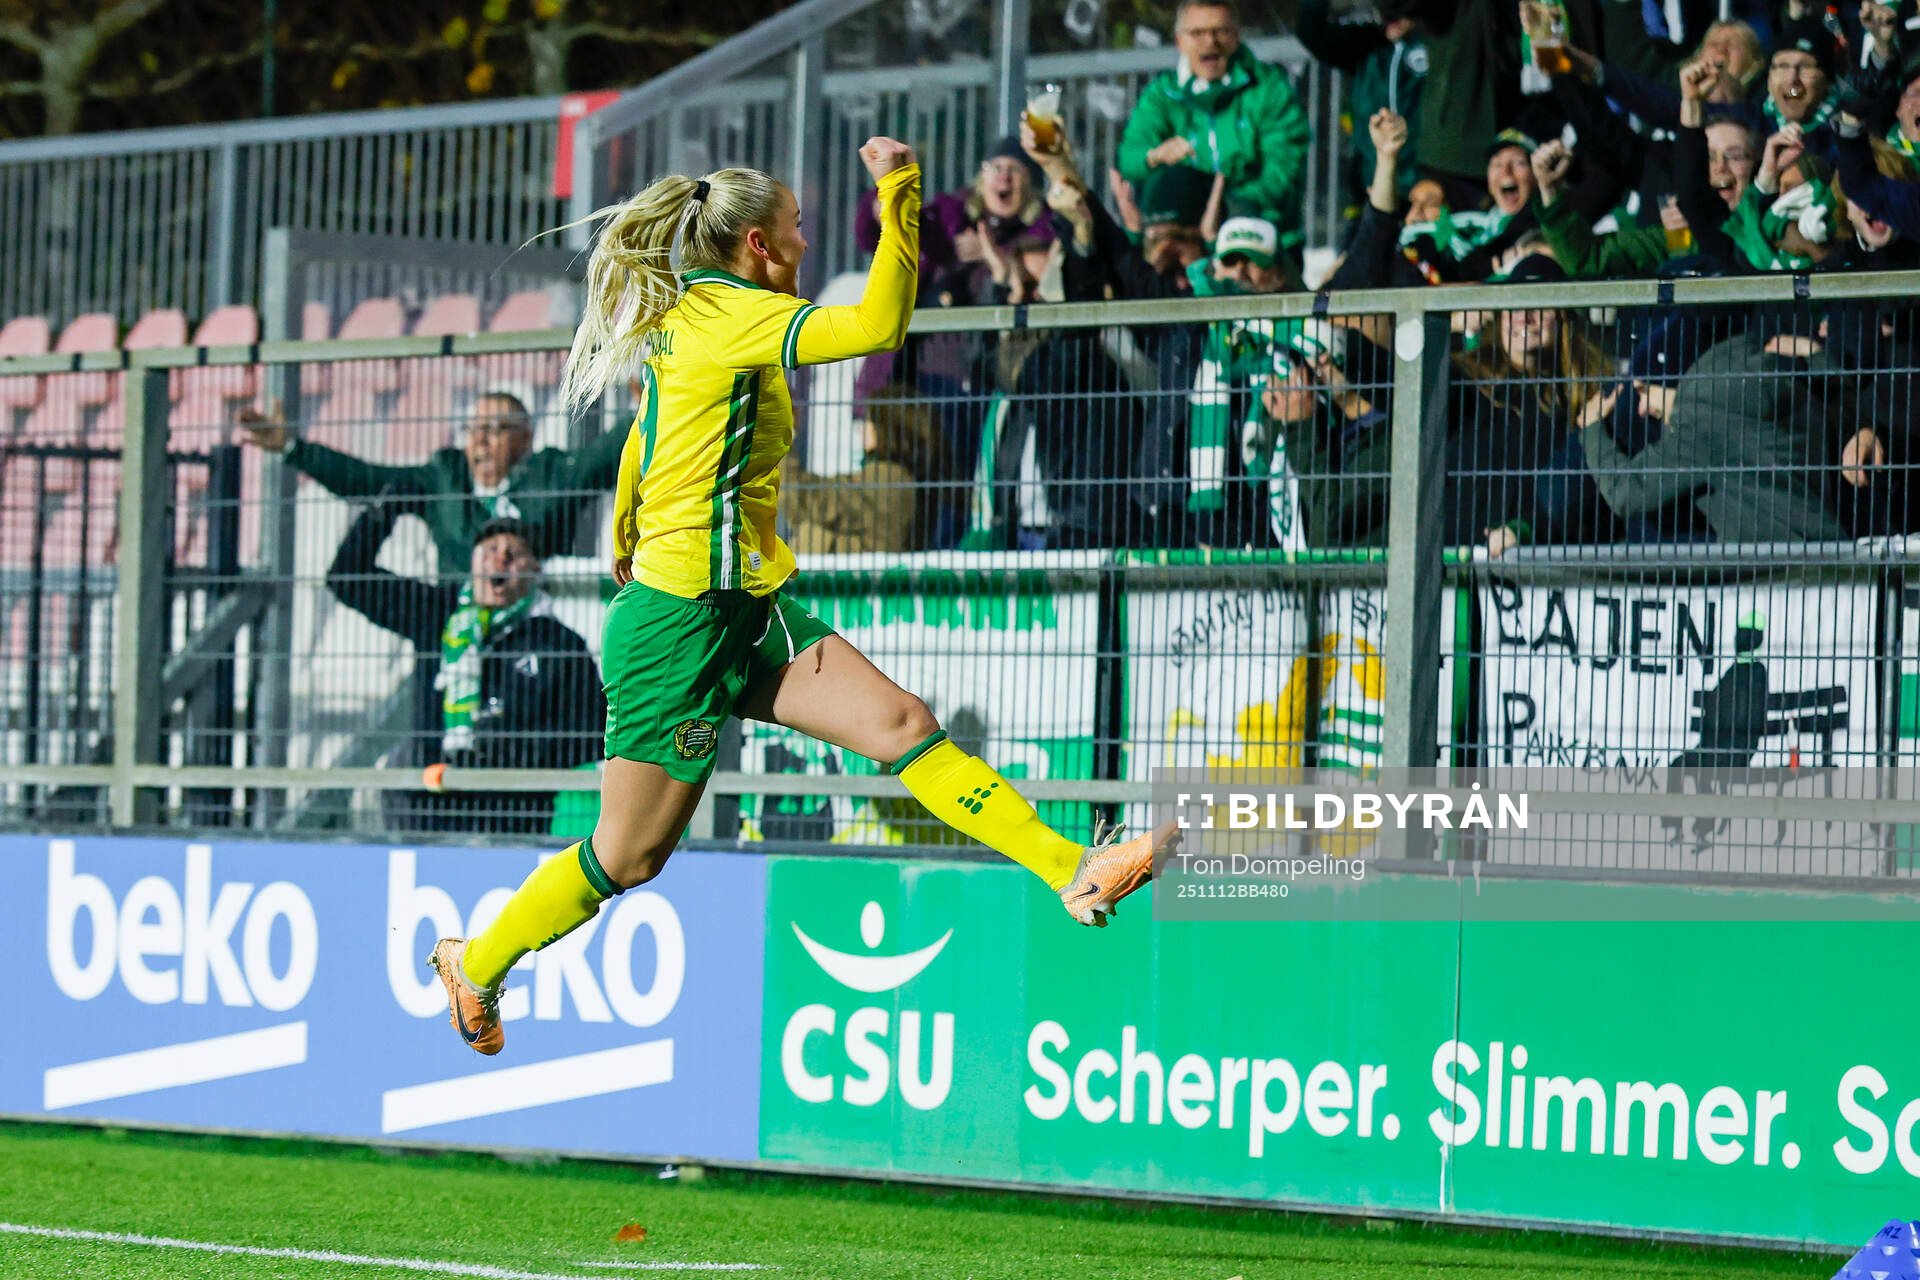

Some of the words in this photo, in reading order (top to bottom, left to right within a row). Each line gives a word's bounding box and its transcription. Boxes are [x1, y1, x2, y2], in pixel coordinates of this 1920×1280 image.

[1488, 569, 1716, 676] BAJEN
[46, 840, 318, 1011] beko
[781, 1003, 955, 1111] CSU
[1024, 1020, 1401, 1158] Scherper.
[1428, 1039, 1801, 1170] Slimmer.
